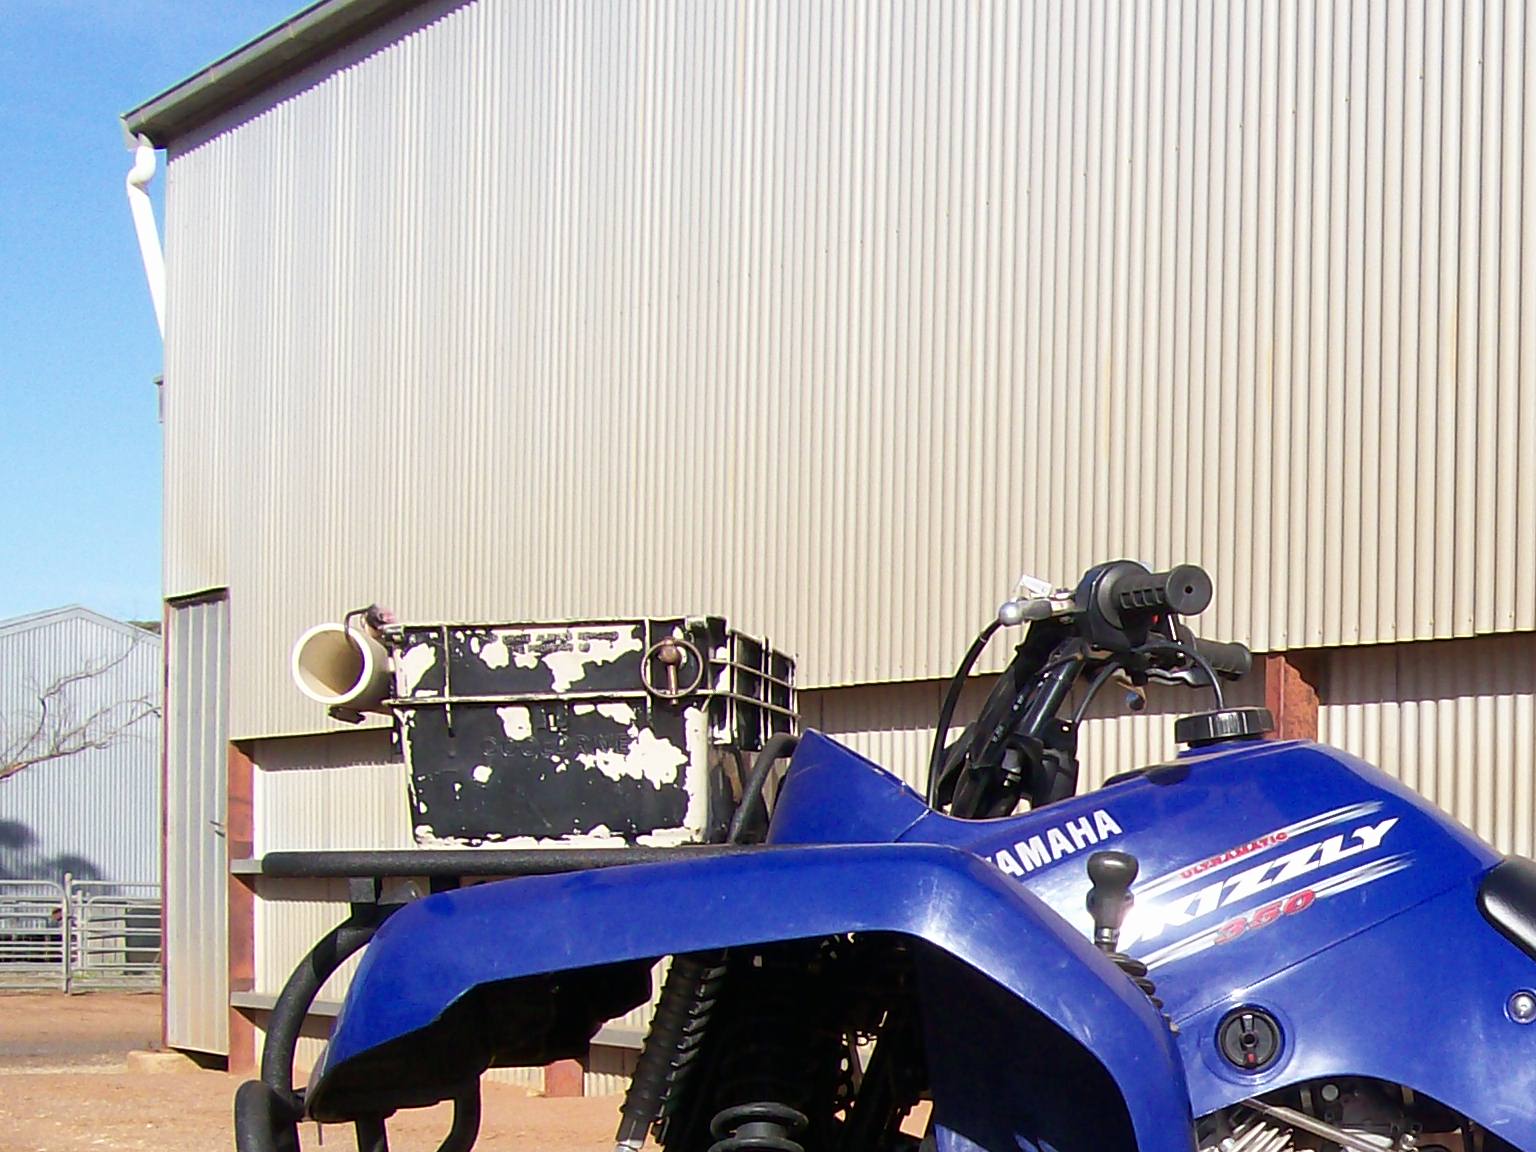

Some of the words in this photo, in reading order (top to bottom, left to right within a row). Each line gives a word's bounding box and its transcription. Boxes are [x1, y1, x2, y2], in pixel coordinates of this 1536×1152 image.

[985, 809, 1123, 877] AMAHA
[1180, 831, 1289, 880] ULTRAMATIC
[1214, 888, 1317, 945] 350
